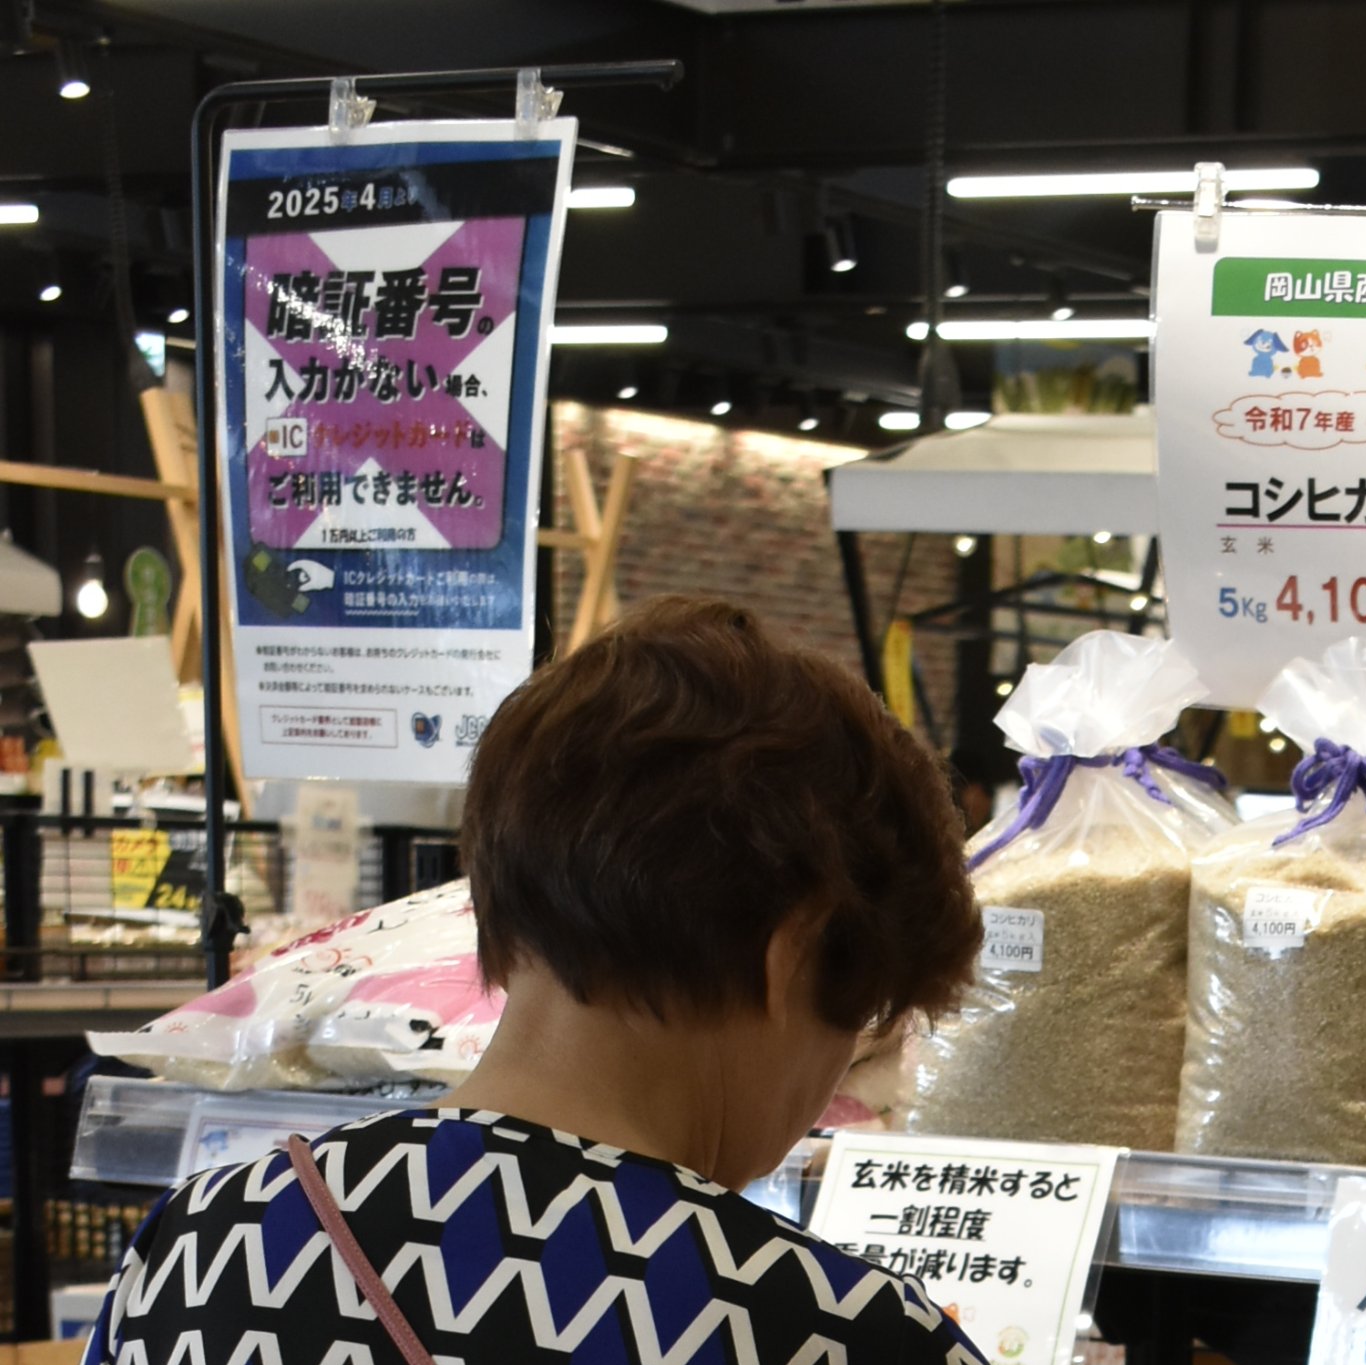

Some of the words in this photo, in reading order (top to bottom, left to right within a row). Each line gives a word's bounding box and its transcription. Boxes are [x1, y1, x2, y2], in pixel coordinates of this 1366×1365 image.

[266, 266, 494, 344] 暗証番号の
[1244, 405, 1356, 433] 令和7年産
[267, 470, 486, 510] ご利用できません。
[1218, 587, 1268, 623] 5Kg
[1252, 921, 1297, 936] 4,100円
[989, 943, 1034, 960] 4,100円
[850, 1159, 1081, 1202] 玄米を精米すると
[869, 1205, 993, 1240] 一割程度
